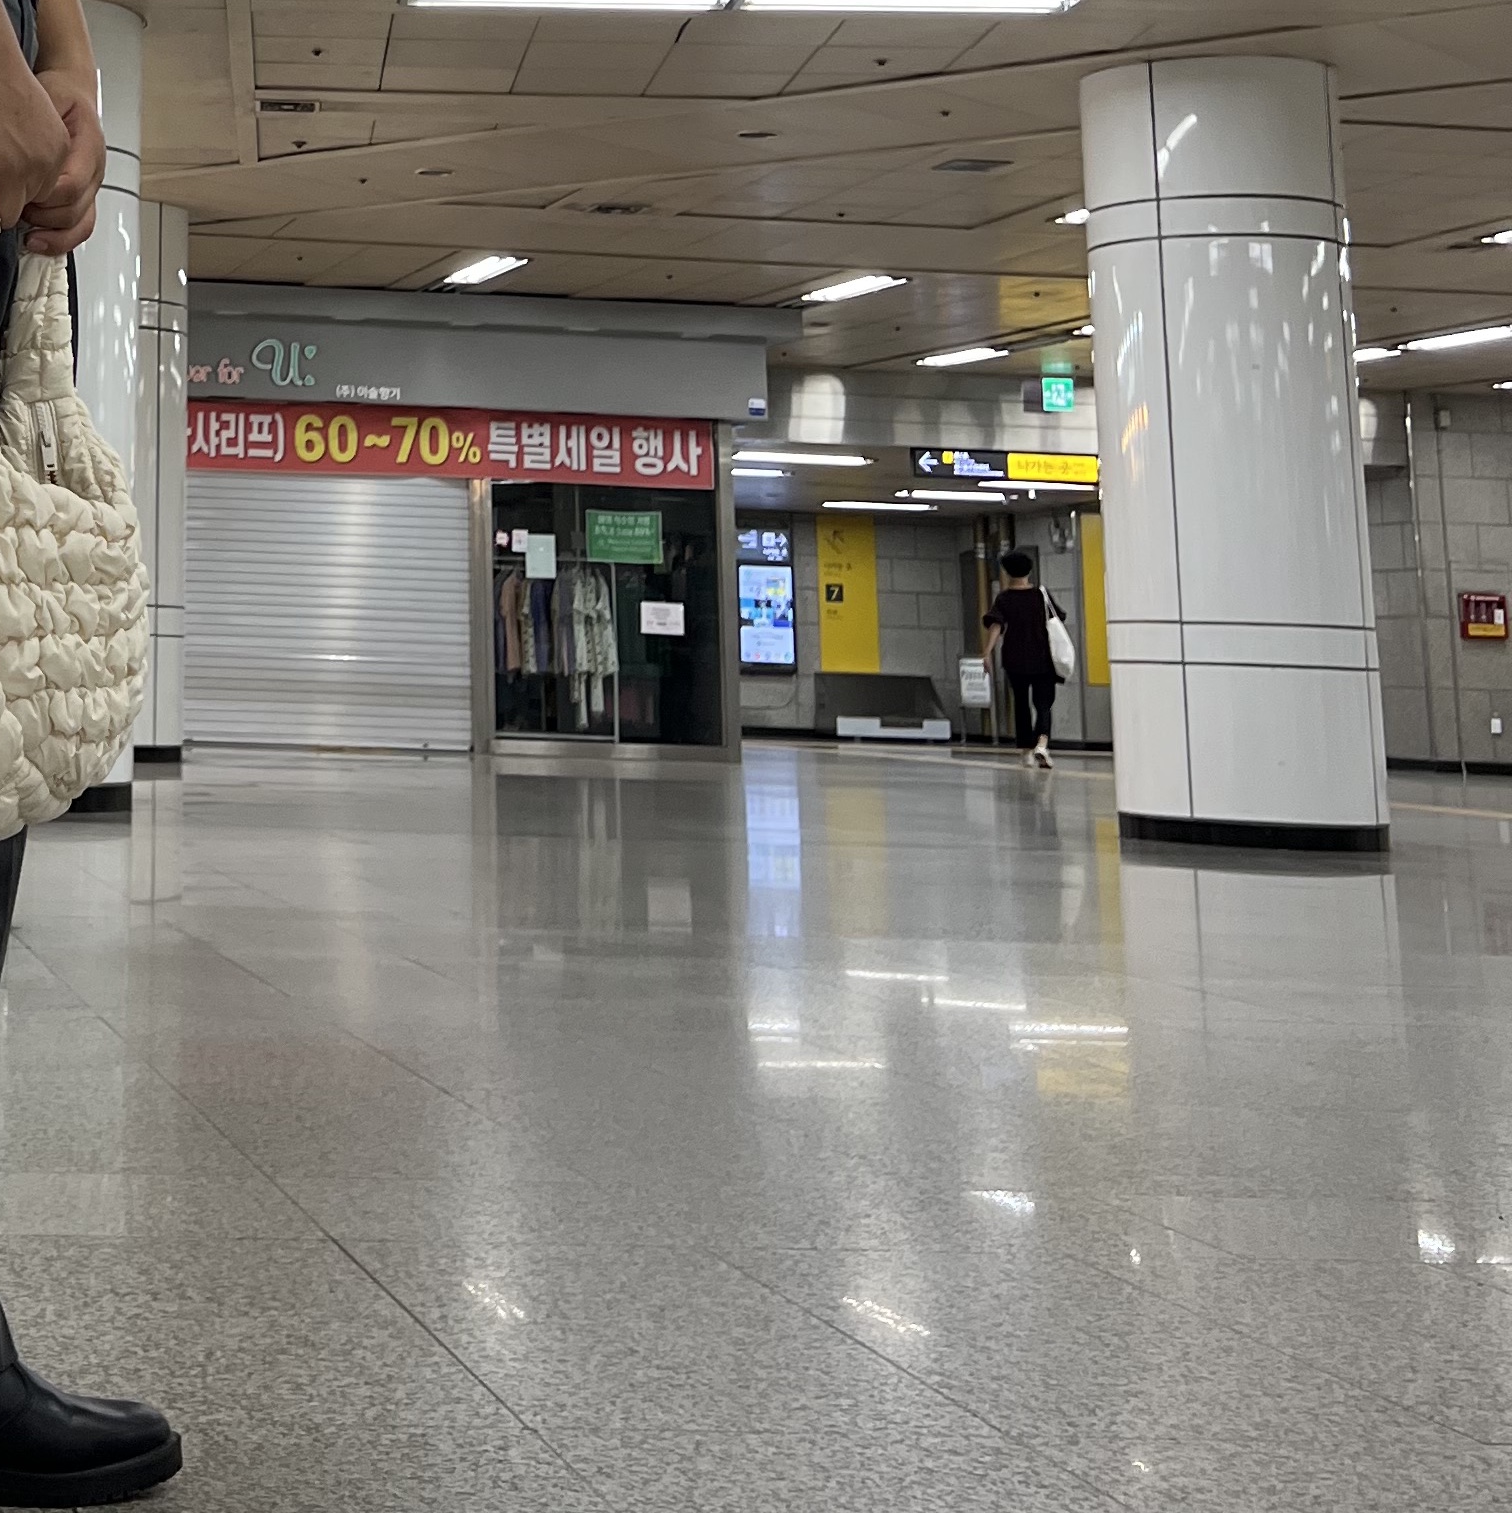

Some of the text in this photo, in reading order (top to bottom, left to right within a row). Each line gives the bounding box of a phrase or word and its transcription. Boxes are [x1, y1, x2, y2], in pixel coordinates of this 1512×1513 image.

[217, 357, 245, 385] for
[186, 410, 703, 477] 샤리프) 60~70% 특별세일 행사
[829, 586, 840, 601] 7
